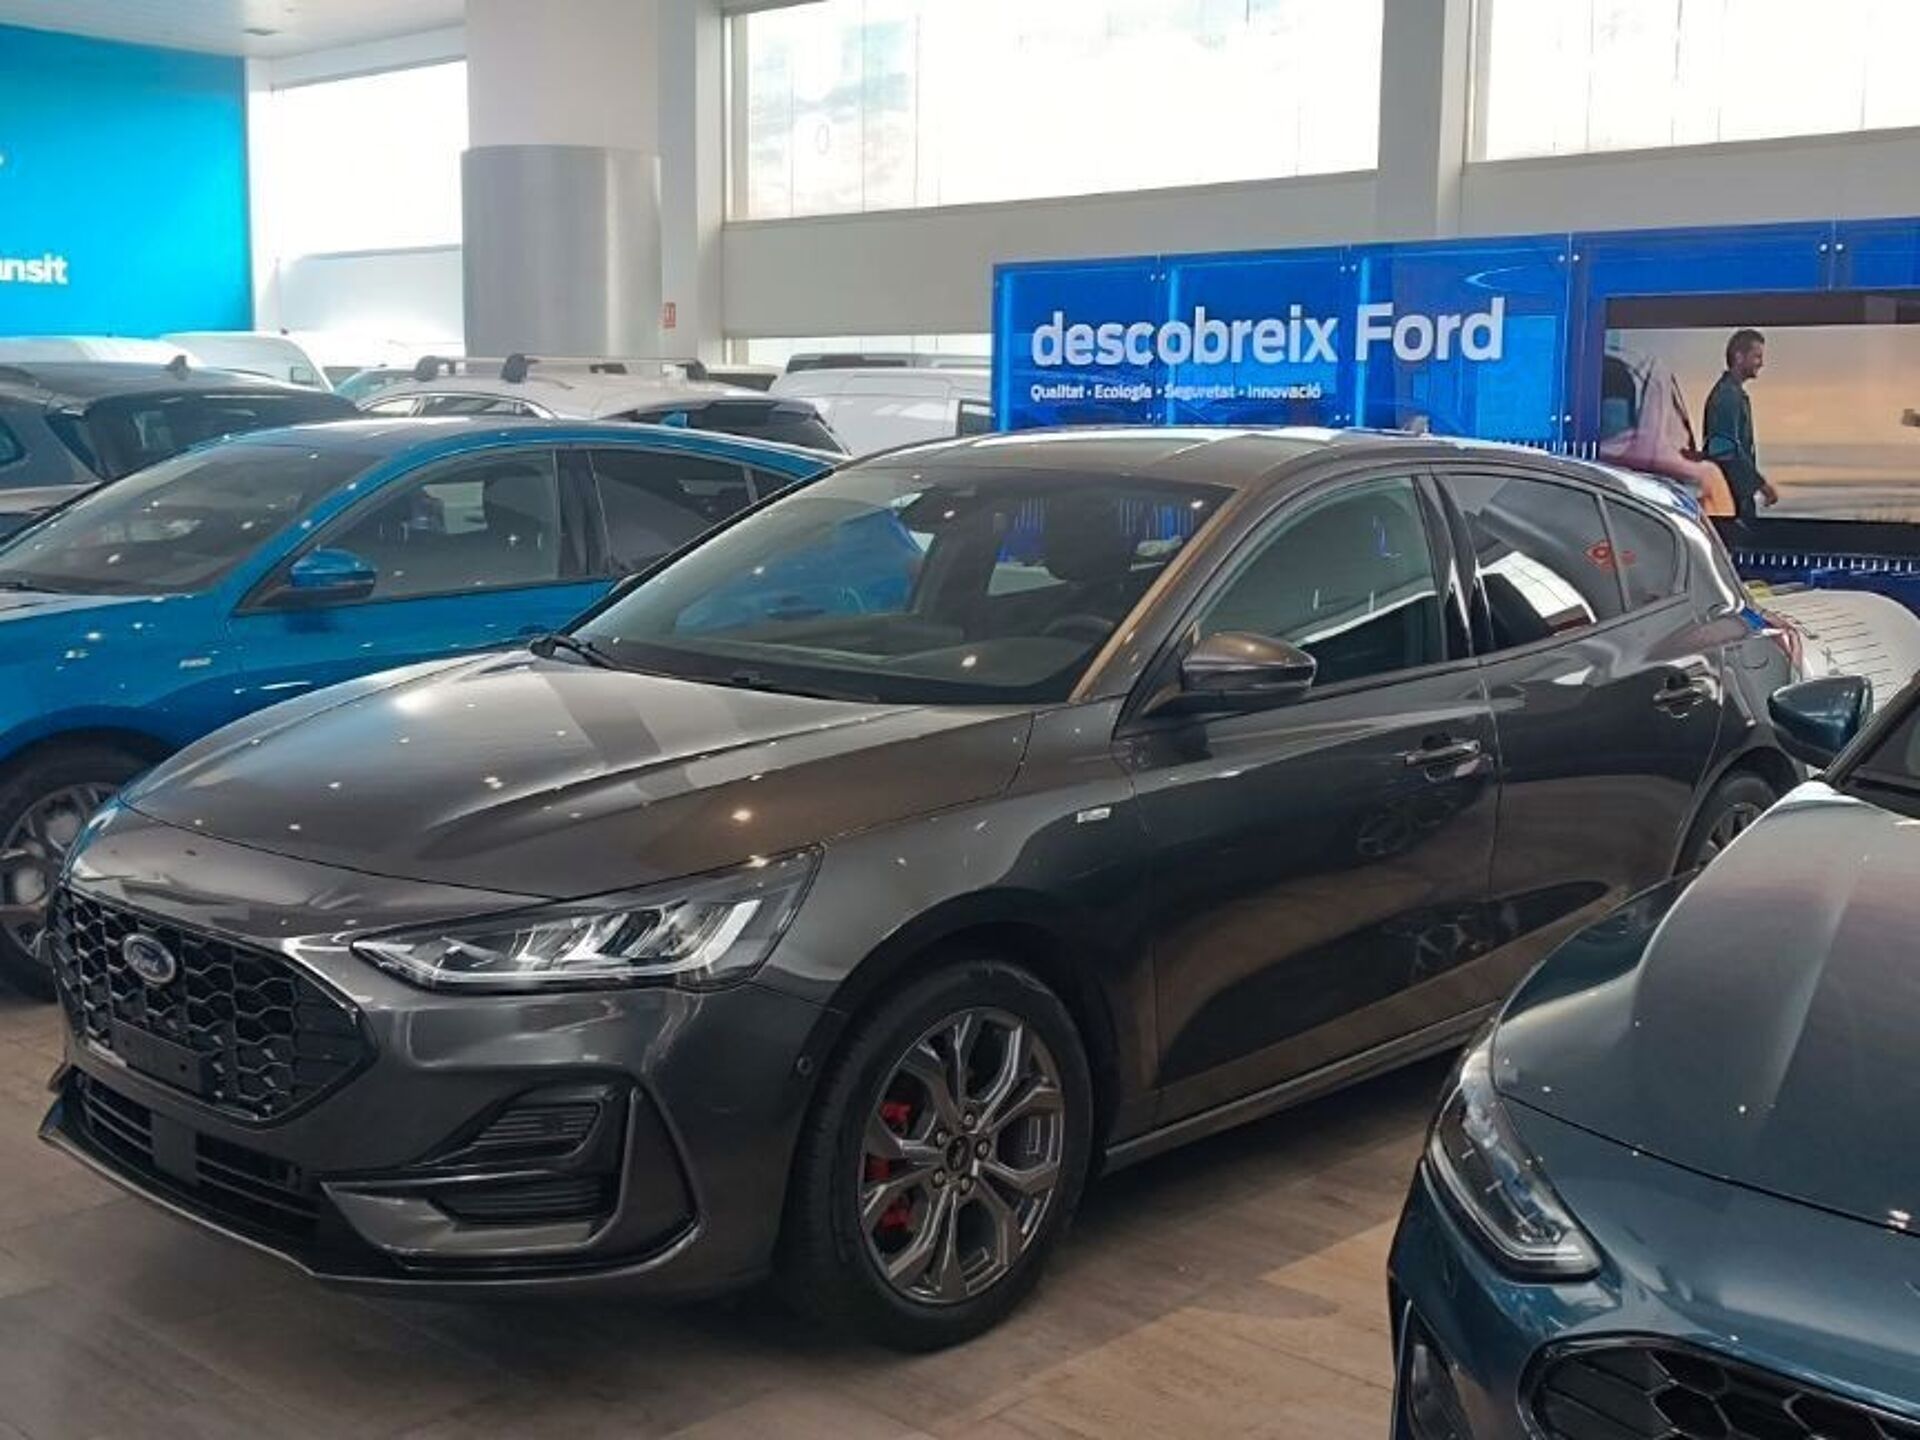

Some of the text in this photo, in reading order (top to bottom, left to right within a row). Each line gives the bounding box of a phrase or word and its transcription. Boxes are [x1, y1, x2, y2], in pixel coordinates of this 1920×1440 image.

[0, 253, 69, 284] nsit
[1031, 297, 1505, 366] descobreix Ford
[1030, 383, 1085, 402] Qualitat
[1248, 381, 1322, 399] Innovació
